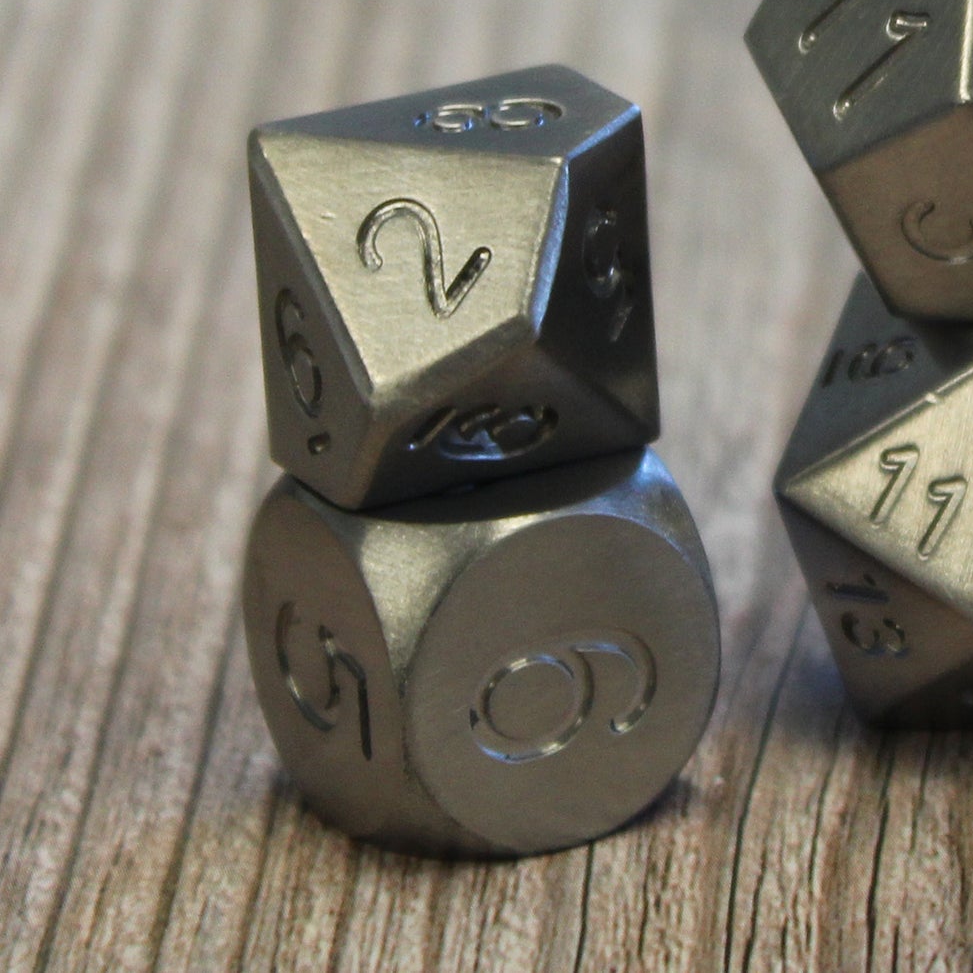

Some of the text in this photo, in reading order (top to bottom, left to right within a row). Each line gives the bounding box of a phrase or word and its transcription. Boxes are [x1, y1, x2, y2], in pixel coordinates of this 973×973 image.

[356, 197, 492, 319] 2
[869, 443, 968, 561] 11
[276, 600, 372, 762] 5
